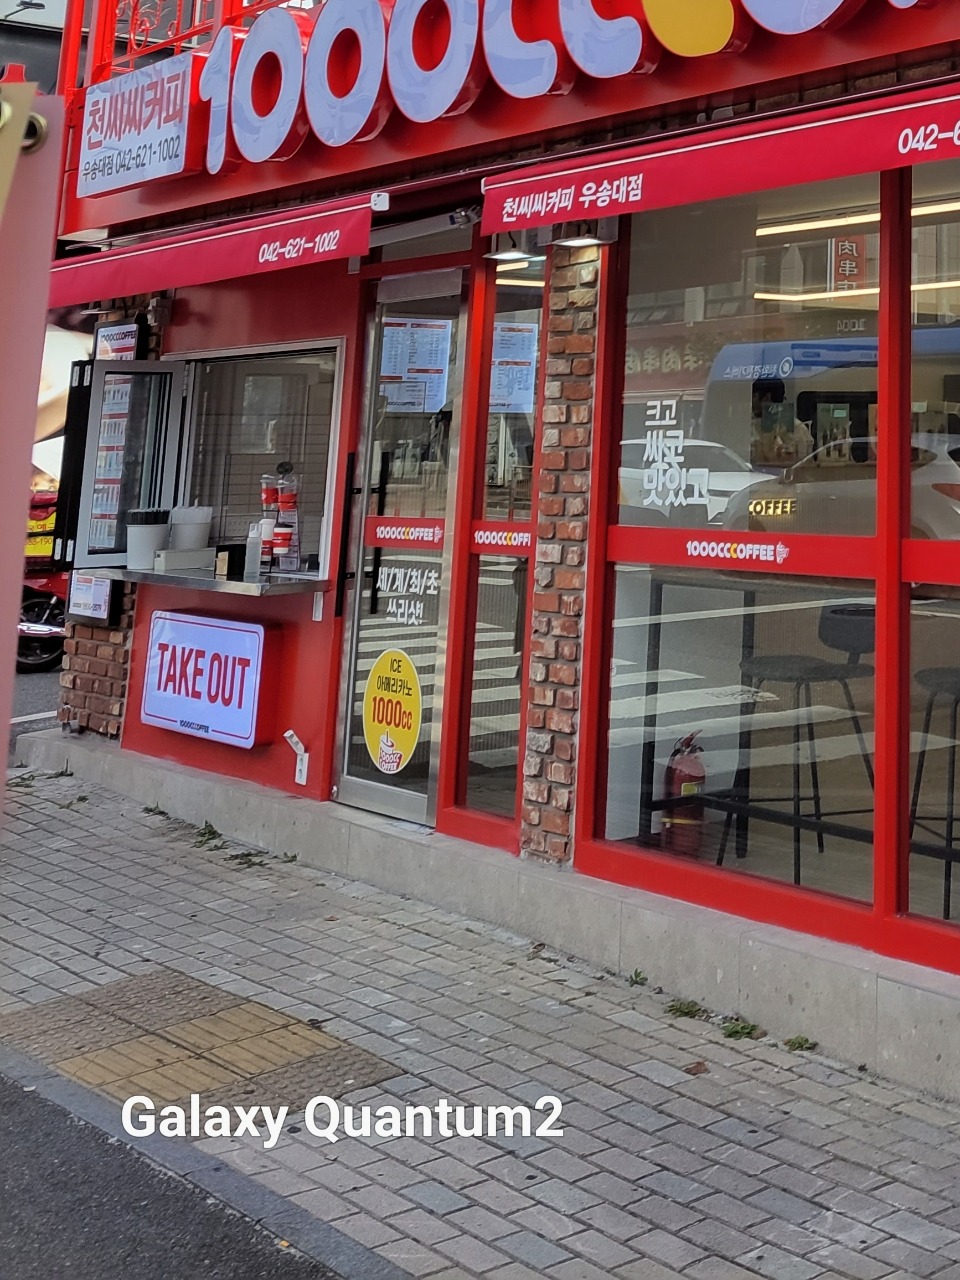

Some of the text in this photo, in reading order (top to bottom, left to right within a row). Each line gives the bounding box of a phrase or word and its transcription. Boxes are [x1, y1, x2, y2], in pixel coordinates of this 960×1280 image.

[86, 68, 186, 151] 천씨씨커피
[82, 134, 180, 182] 우송대점 042-621-1002
[502, 184, 575, 223] 천씨씨커피
[578, 173, 643, 211] 우송대점
[258, 229, 340, 264] 042-621-1002
[644, 399, 677, 426] 크고
[642, 430, 685, 468] 싸고
[642, 464, 710, 508] 맛있고
[157, 642, 251, 710] TAKE OUT
[376, 675, 413, 697] 아메리카노
[390, 658, 402, 674] ICE
